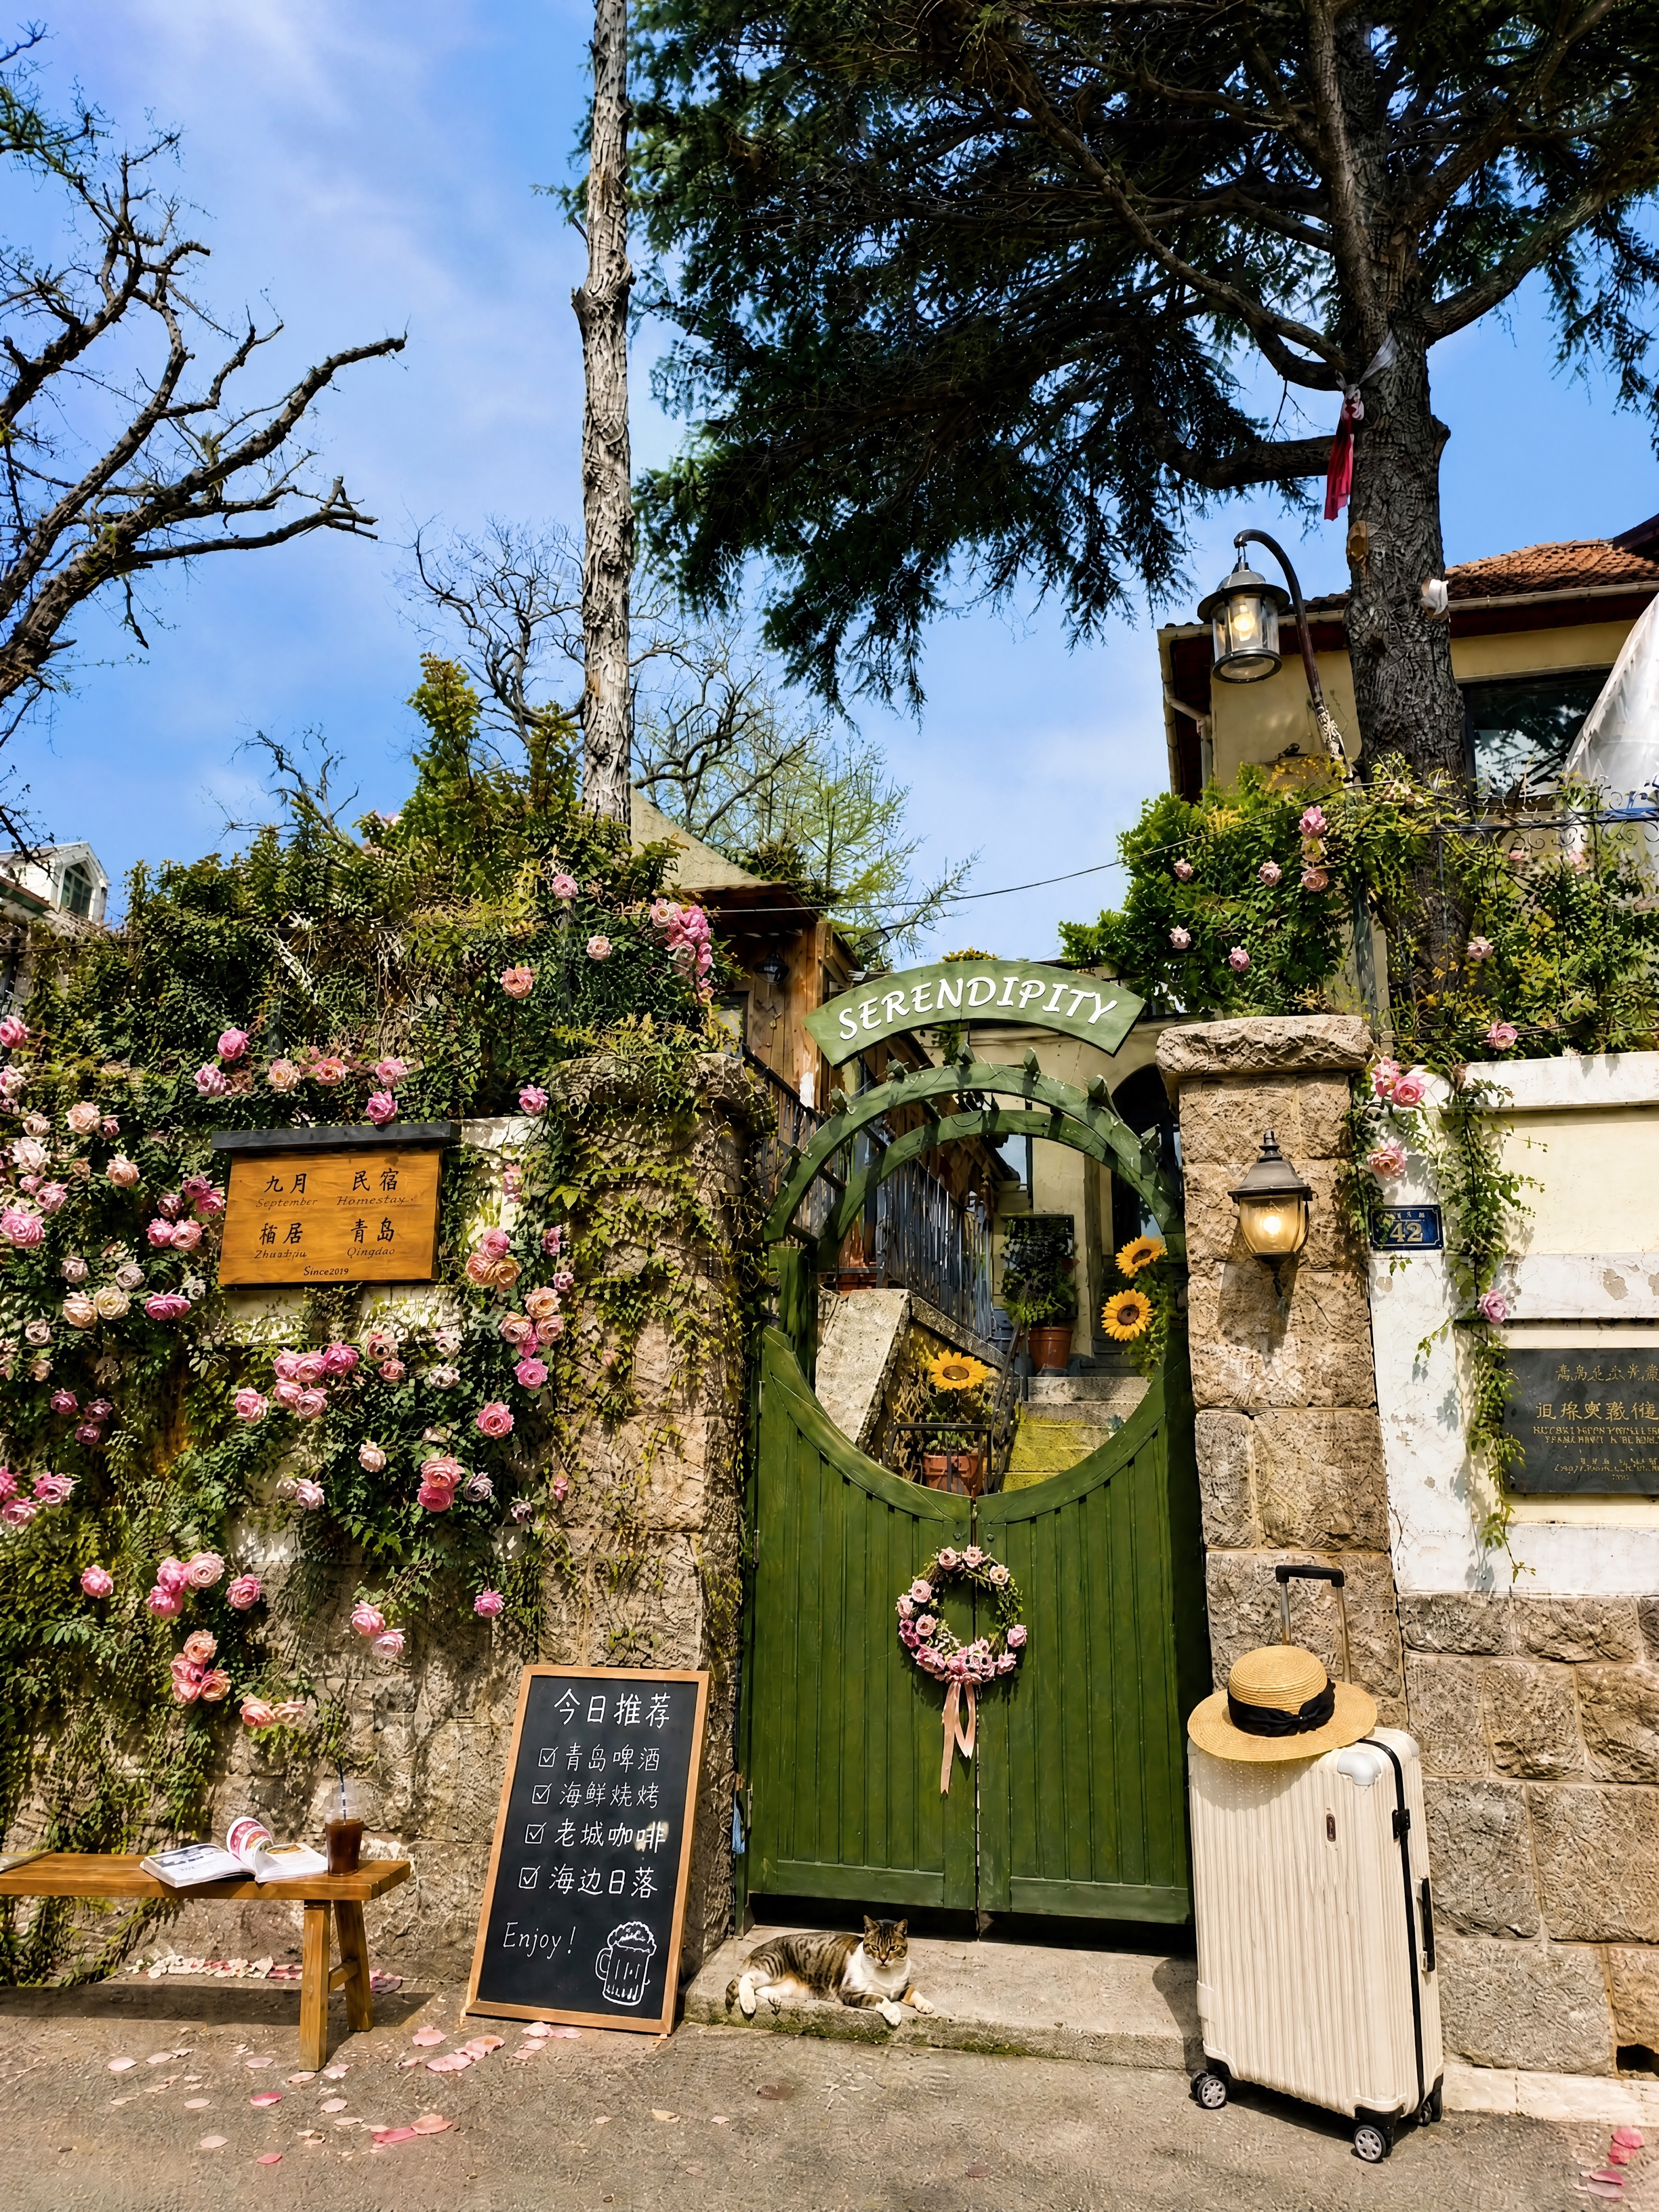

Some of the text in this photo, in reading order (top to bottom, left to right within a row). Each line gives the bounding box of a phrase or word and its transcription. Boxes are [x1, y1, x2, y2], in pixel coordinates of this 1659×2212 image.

[838, 976, 1118, 1041] SERENDIPITY
[264, 1167, 399, 1194] 九月 民宿
[255, 1195, 406, 1210] September Homestay
[350, 1216, 395, 1244] 青岛
[1389, 1223, 1423, 1242] 42
[346, 1246, 395, 1259] Qingdao
[554, 1688, 671, 1729] 今日推荐
[566, 1742, 660, 1774] 青岛啤酒
[559, 1780, 659, 1809] 海鲜烧烤
[554, 1818, 666, 1853] 老城咖啡
[549, 1863, 658, 1898] 海边日落
